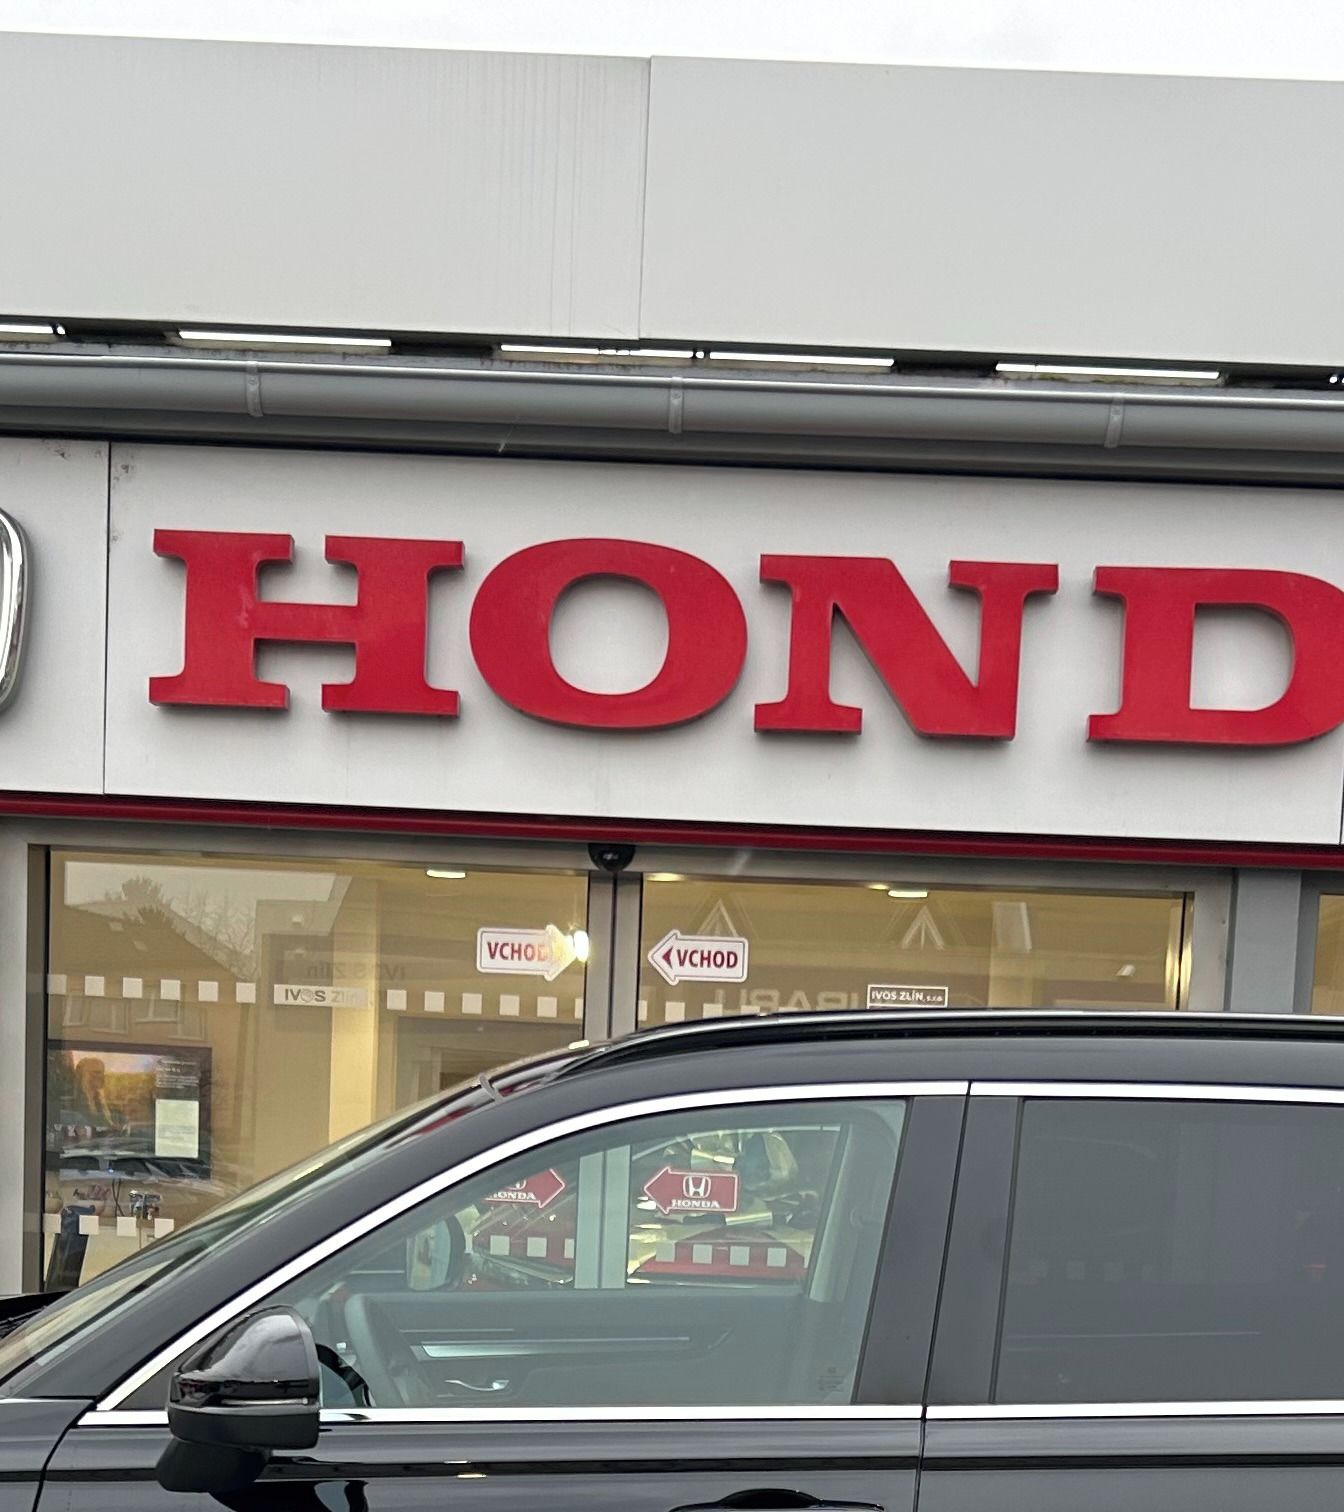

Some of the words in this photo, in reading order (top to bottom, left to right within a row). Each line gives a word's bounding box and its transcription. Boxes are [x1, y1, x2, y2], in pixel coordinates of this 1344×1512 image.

[676, 949, 739, 969] VCHOD
[871, 991, 897, 1001] IVOS
[671, 1199, 721, 1209] HONDA
